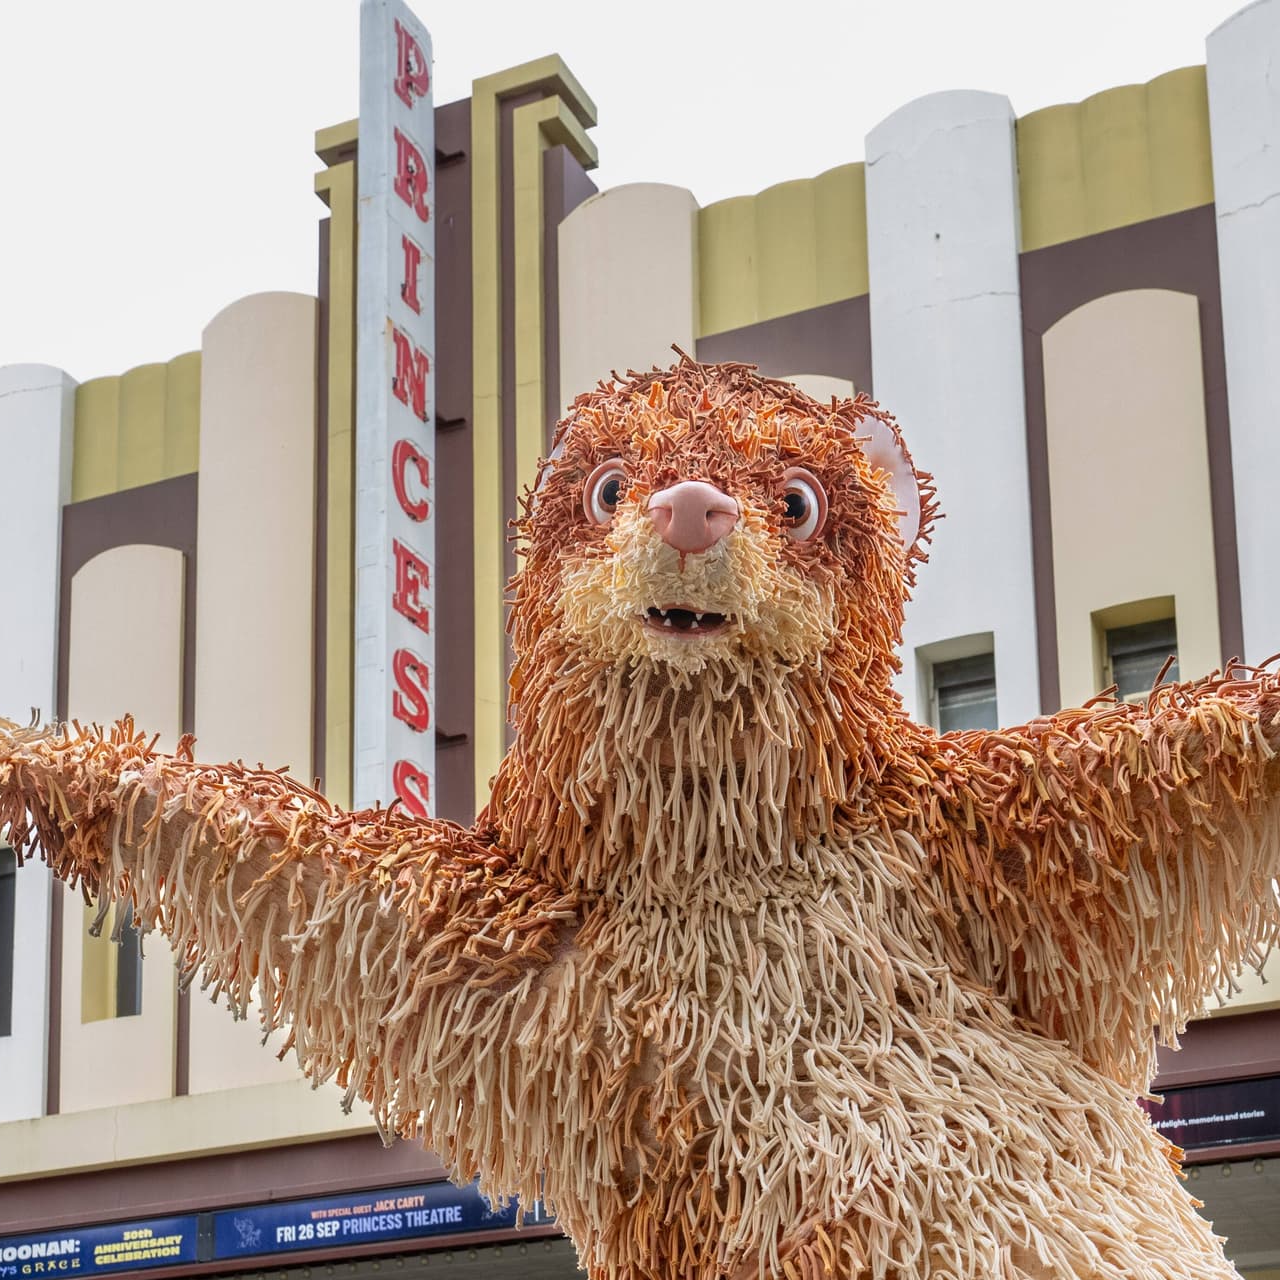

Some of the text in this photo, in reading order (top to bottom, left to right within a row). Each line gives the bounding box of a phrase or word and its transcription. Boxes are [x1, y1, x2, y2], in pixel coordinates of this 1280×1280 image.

[391, 16, 432, 820] PRINCESS
[1161, 1118, 1189, 1129] delight,
[1189, 1114, 1225, 1125] memories
[1225, 1111, 1239, 1121] and
[1240, 1109, 1265, 1119] stories
[311, 1195, 425, 1220] WITH SPECIAL GUEST JACK CARTY
[276, 1206, 462, 1243] FRI 26 SEP PRINCESS THEATRE
[94, 1235, 183, 1255] ANNIVERSARY
[95, 1246, 180, 1265] CELEBRATION
[22, 1258, 81, 1274] GRACE
